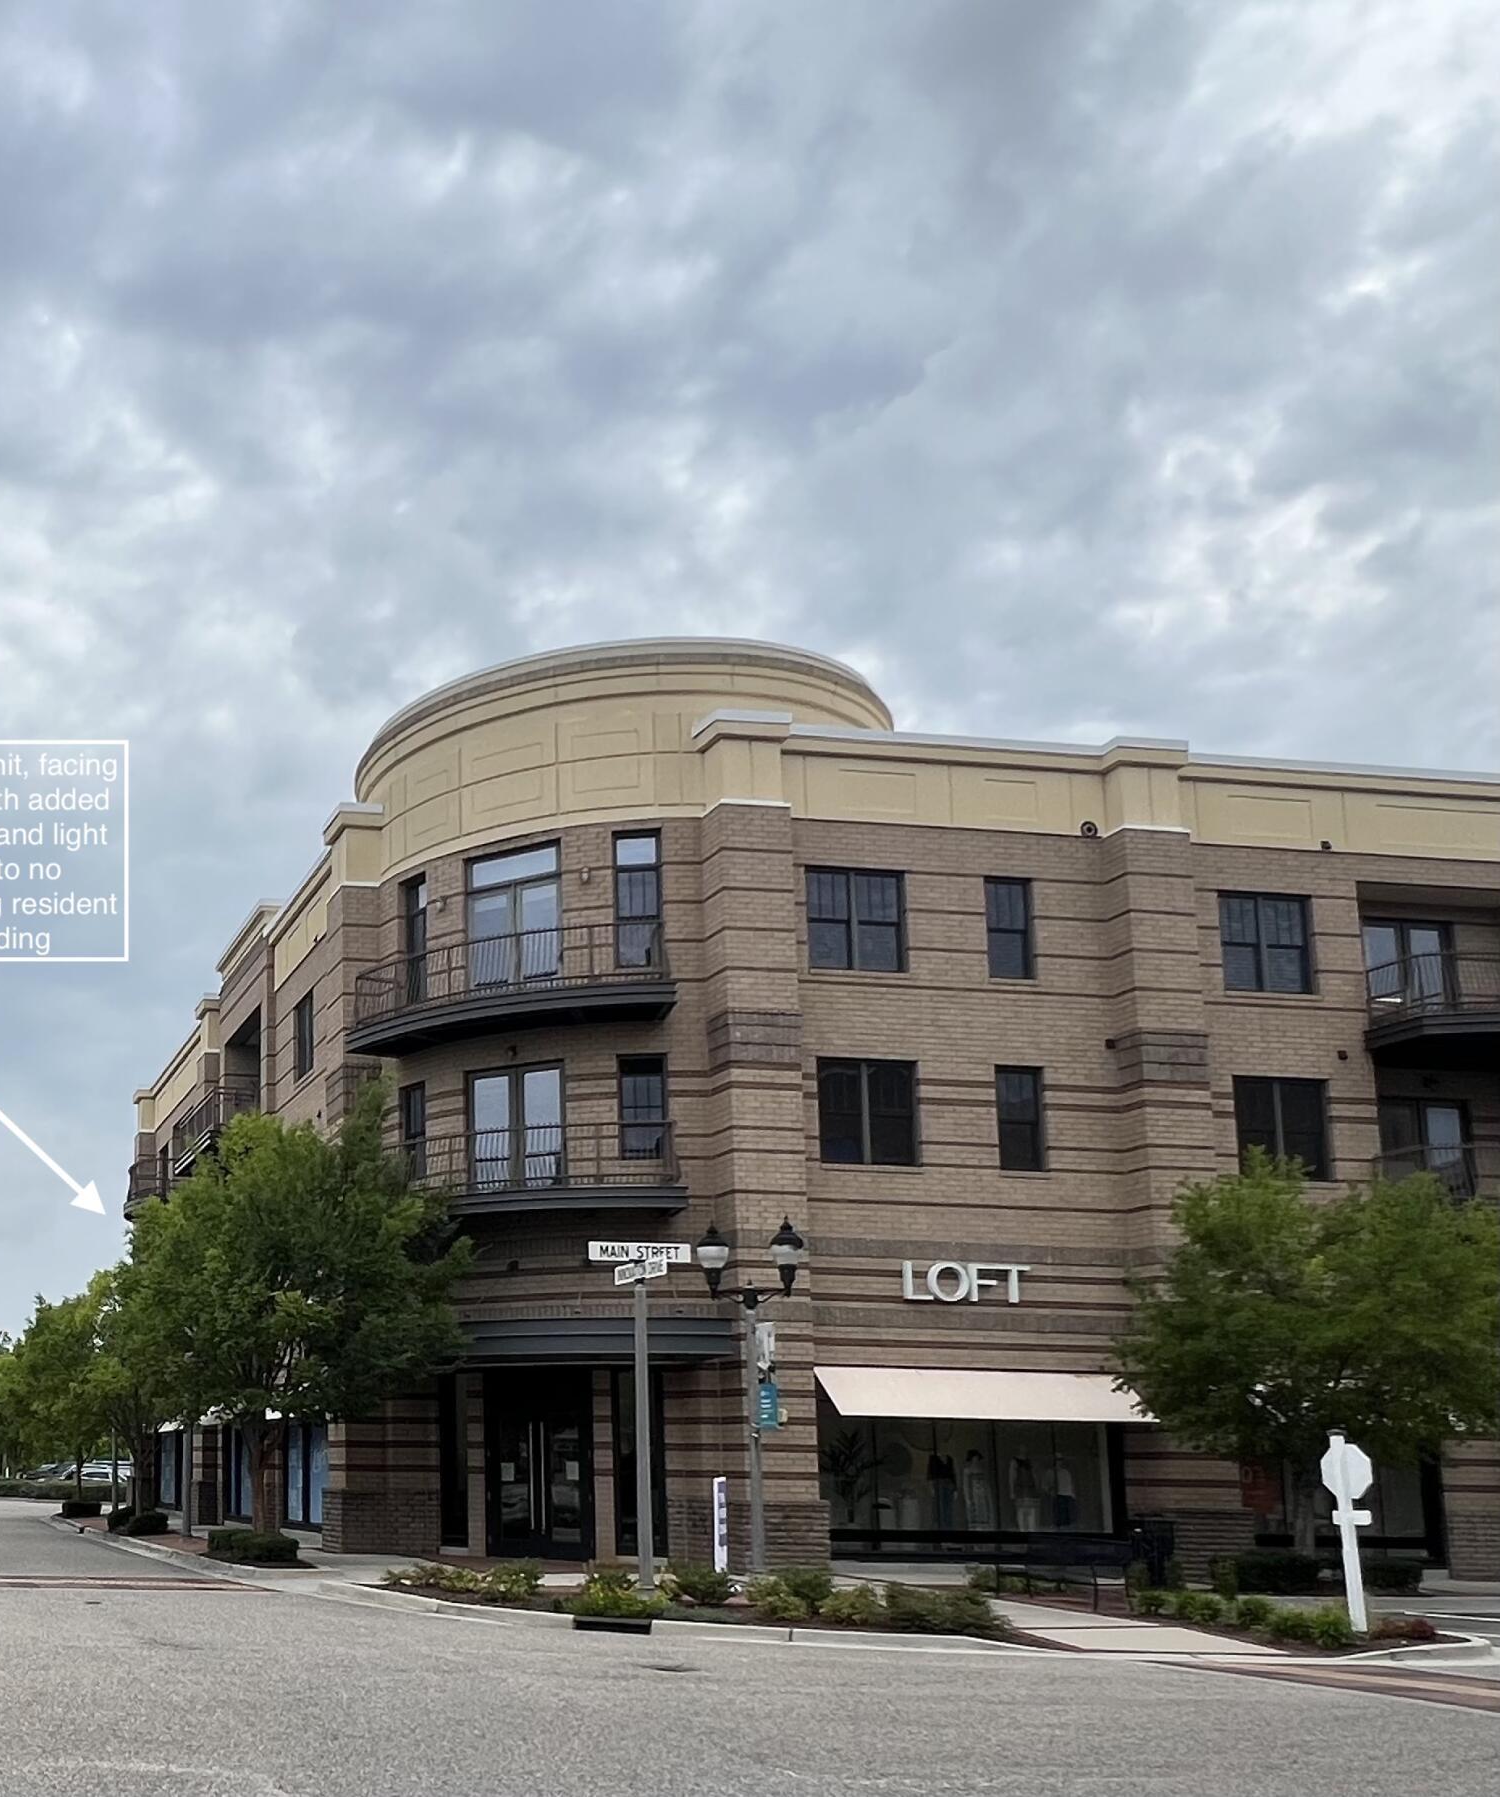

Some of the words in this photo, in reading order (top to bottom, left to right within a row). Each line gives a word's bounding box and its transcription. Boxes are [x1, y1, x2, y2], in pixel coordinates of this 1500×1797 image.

[600, 1245, 629, 1258] MAIN
[636, 1246, 680, 1260] STREET
[902, 1260, 1032, 1303] LOFT
